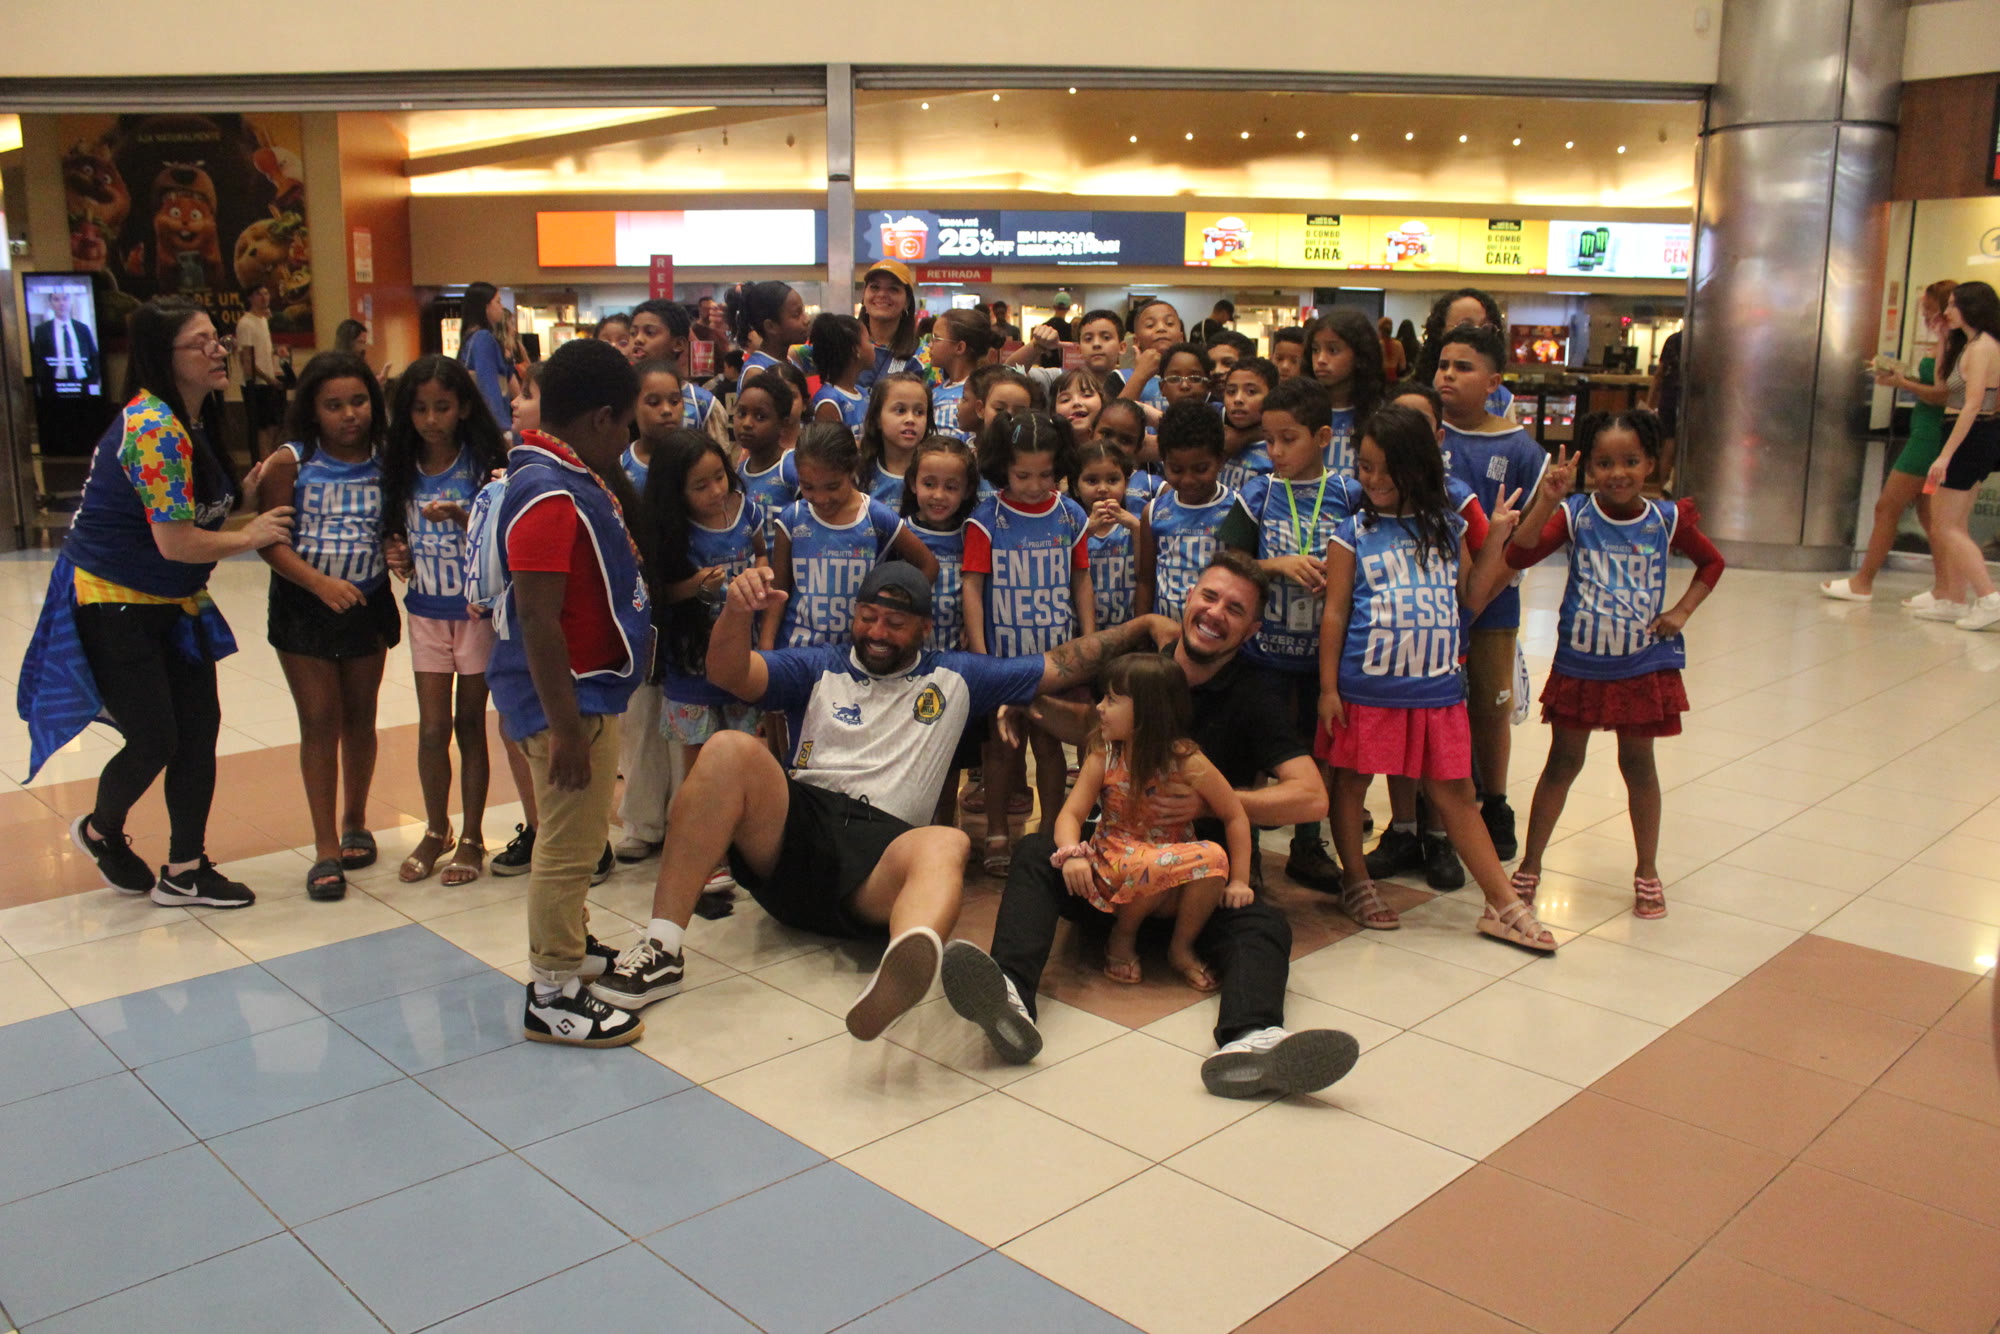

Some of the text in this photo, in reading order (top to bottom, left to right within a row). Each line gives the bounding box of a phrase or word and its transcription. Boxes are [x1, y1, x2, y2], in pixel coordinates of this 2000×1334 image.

[1313, 230, 1340, 238] COMBO
[980, 240, 1016, 256] OFF
[1305, 247, 1341, 260] CARA
[1486, 252, 1522, 265] CARA
[927, 269, 981, 280] RETIRADA
[302, 482, 382, 517] ENTR
[792, 557, 876, 595] ENTR
[1577, 547, 1663, 590] ENTRE
[992, 587, 1076, 626] NESS
[1256, 631, 1294, 646] FAZER
